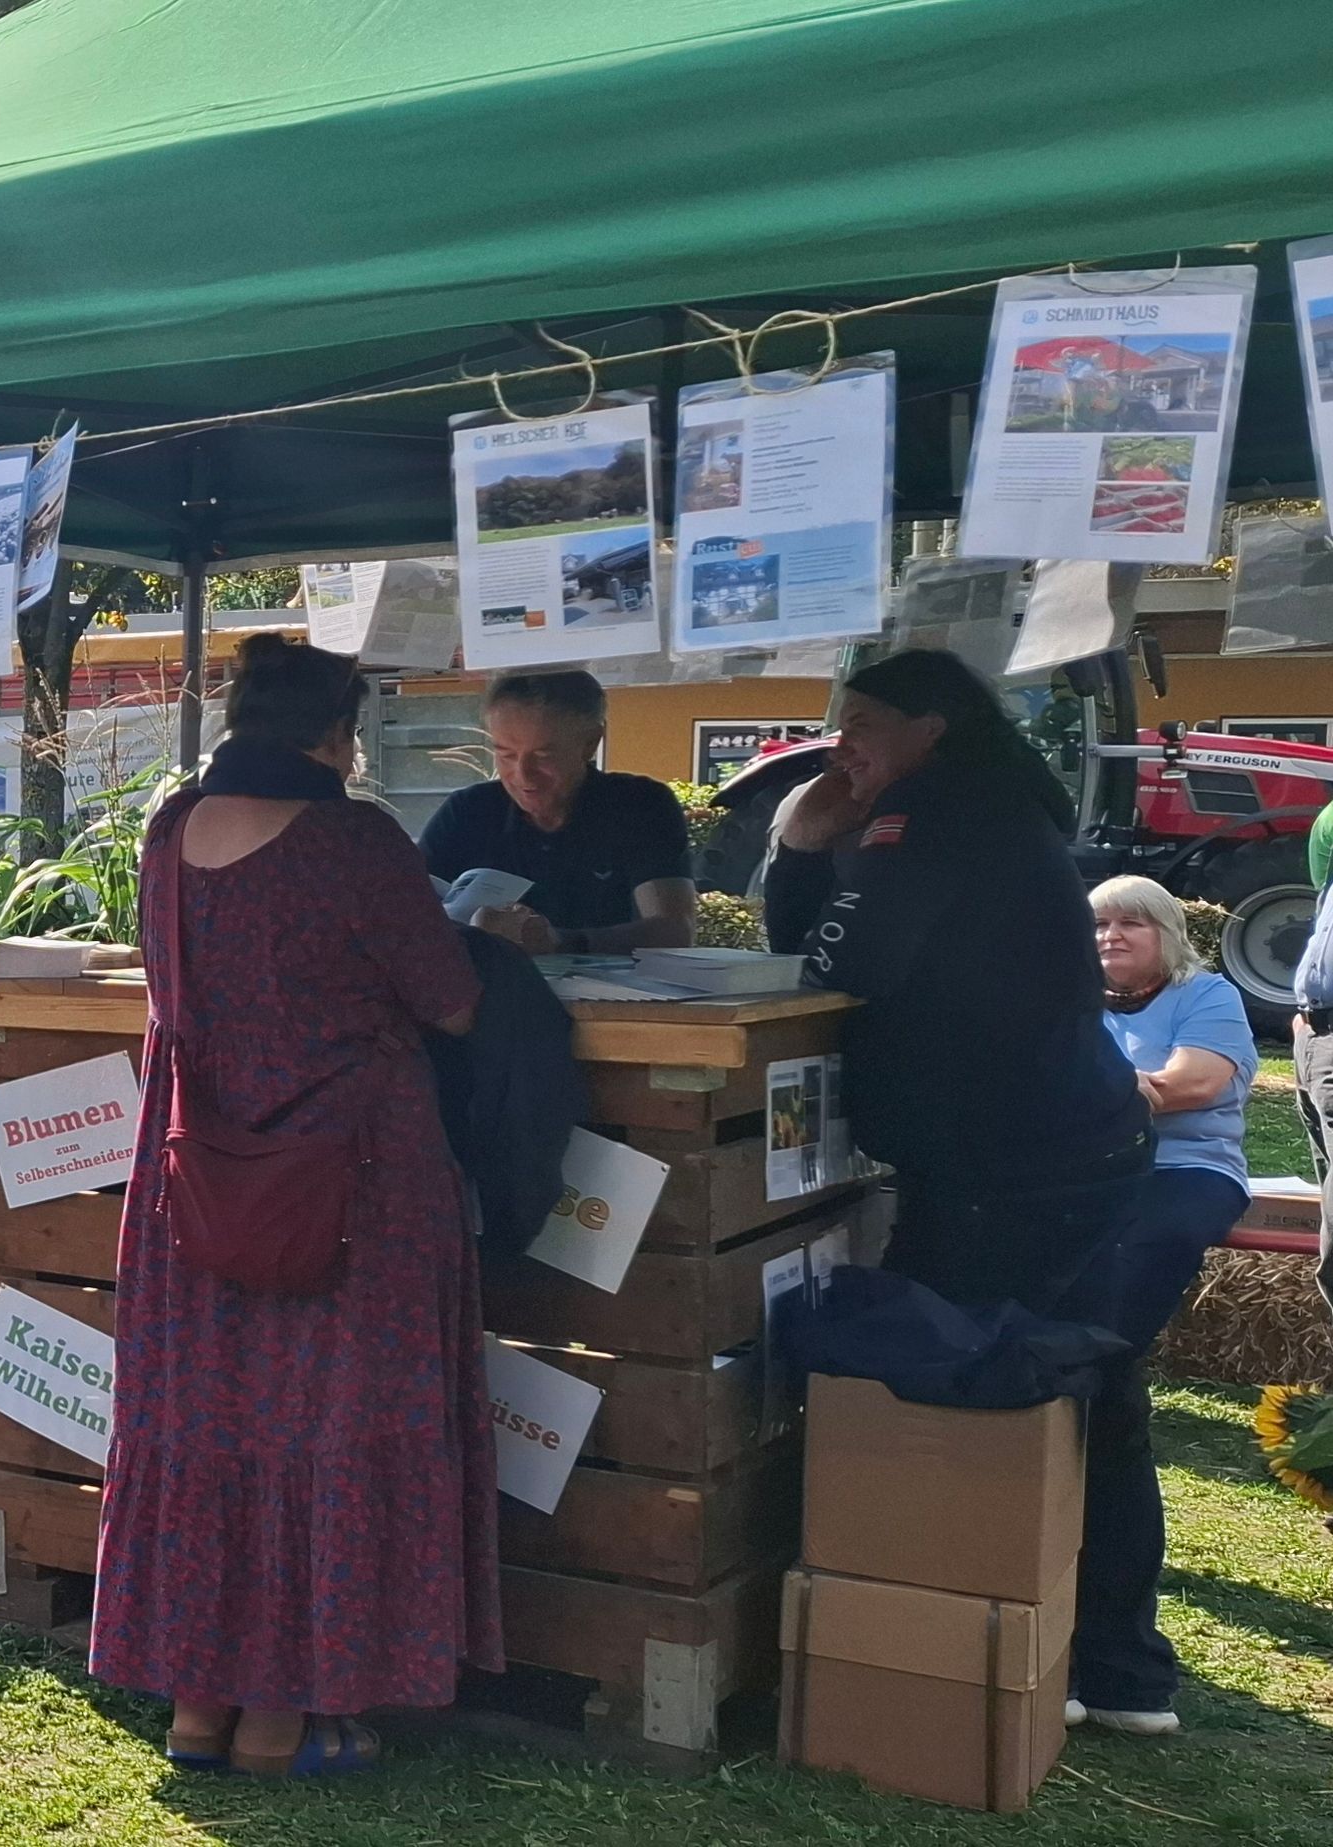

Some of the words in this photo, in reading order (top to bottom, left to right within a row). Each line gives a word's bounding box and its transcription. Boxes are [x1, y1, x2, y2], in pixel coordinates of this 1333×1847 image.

[1045, 305, 1159, 322] SCHMIDTHAUS
[565, 421, 588, 439] HOF
[1206, 754, 1281, 769] FERGUSON
[68, 774, 95, 787] ute
[1, 1096, 125, 1149] Blumen
[54, 1141, 81, 1157] zum
[14, 1146, 135, 1186] Selberschneiden
[553, 1184, 612, 1231] se
[4, 1314, 114, 1394] Kaiser
[490, 1396, 562, 1452] üsse
